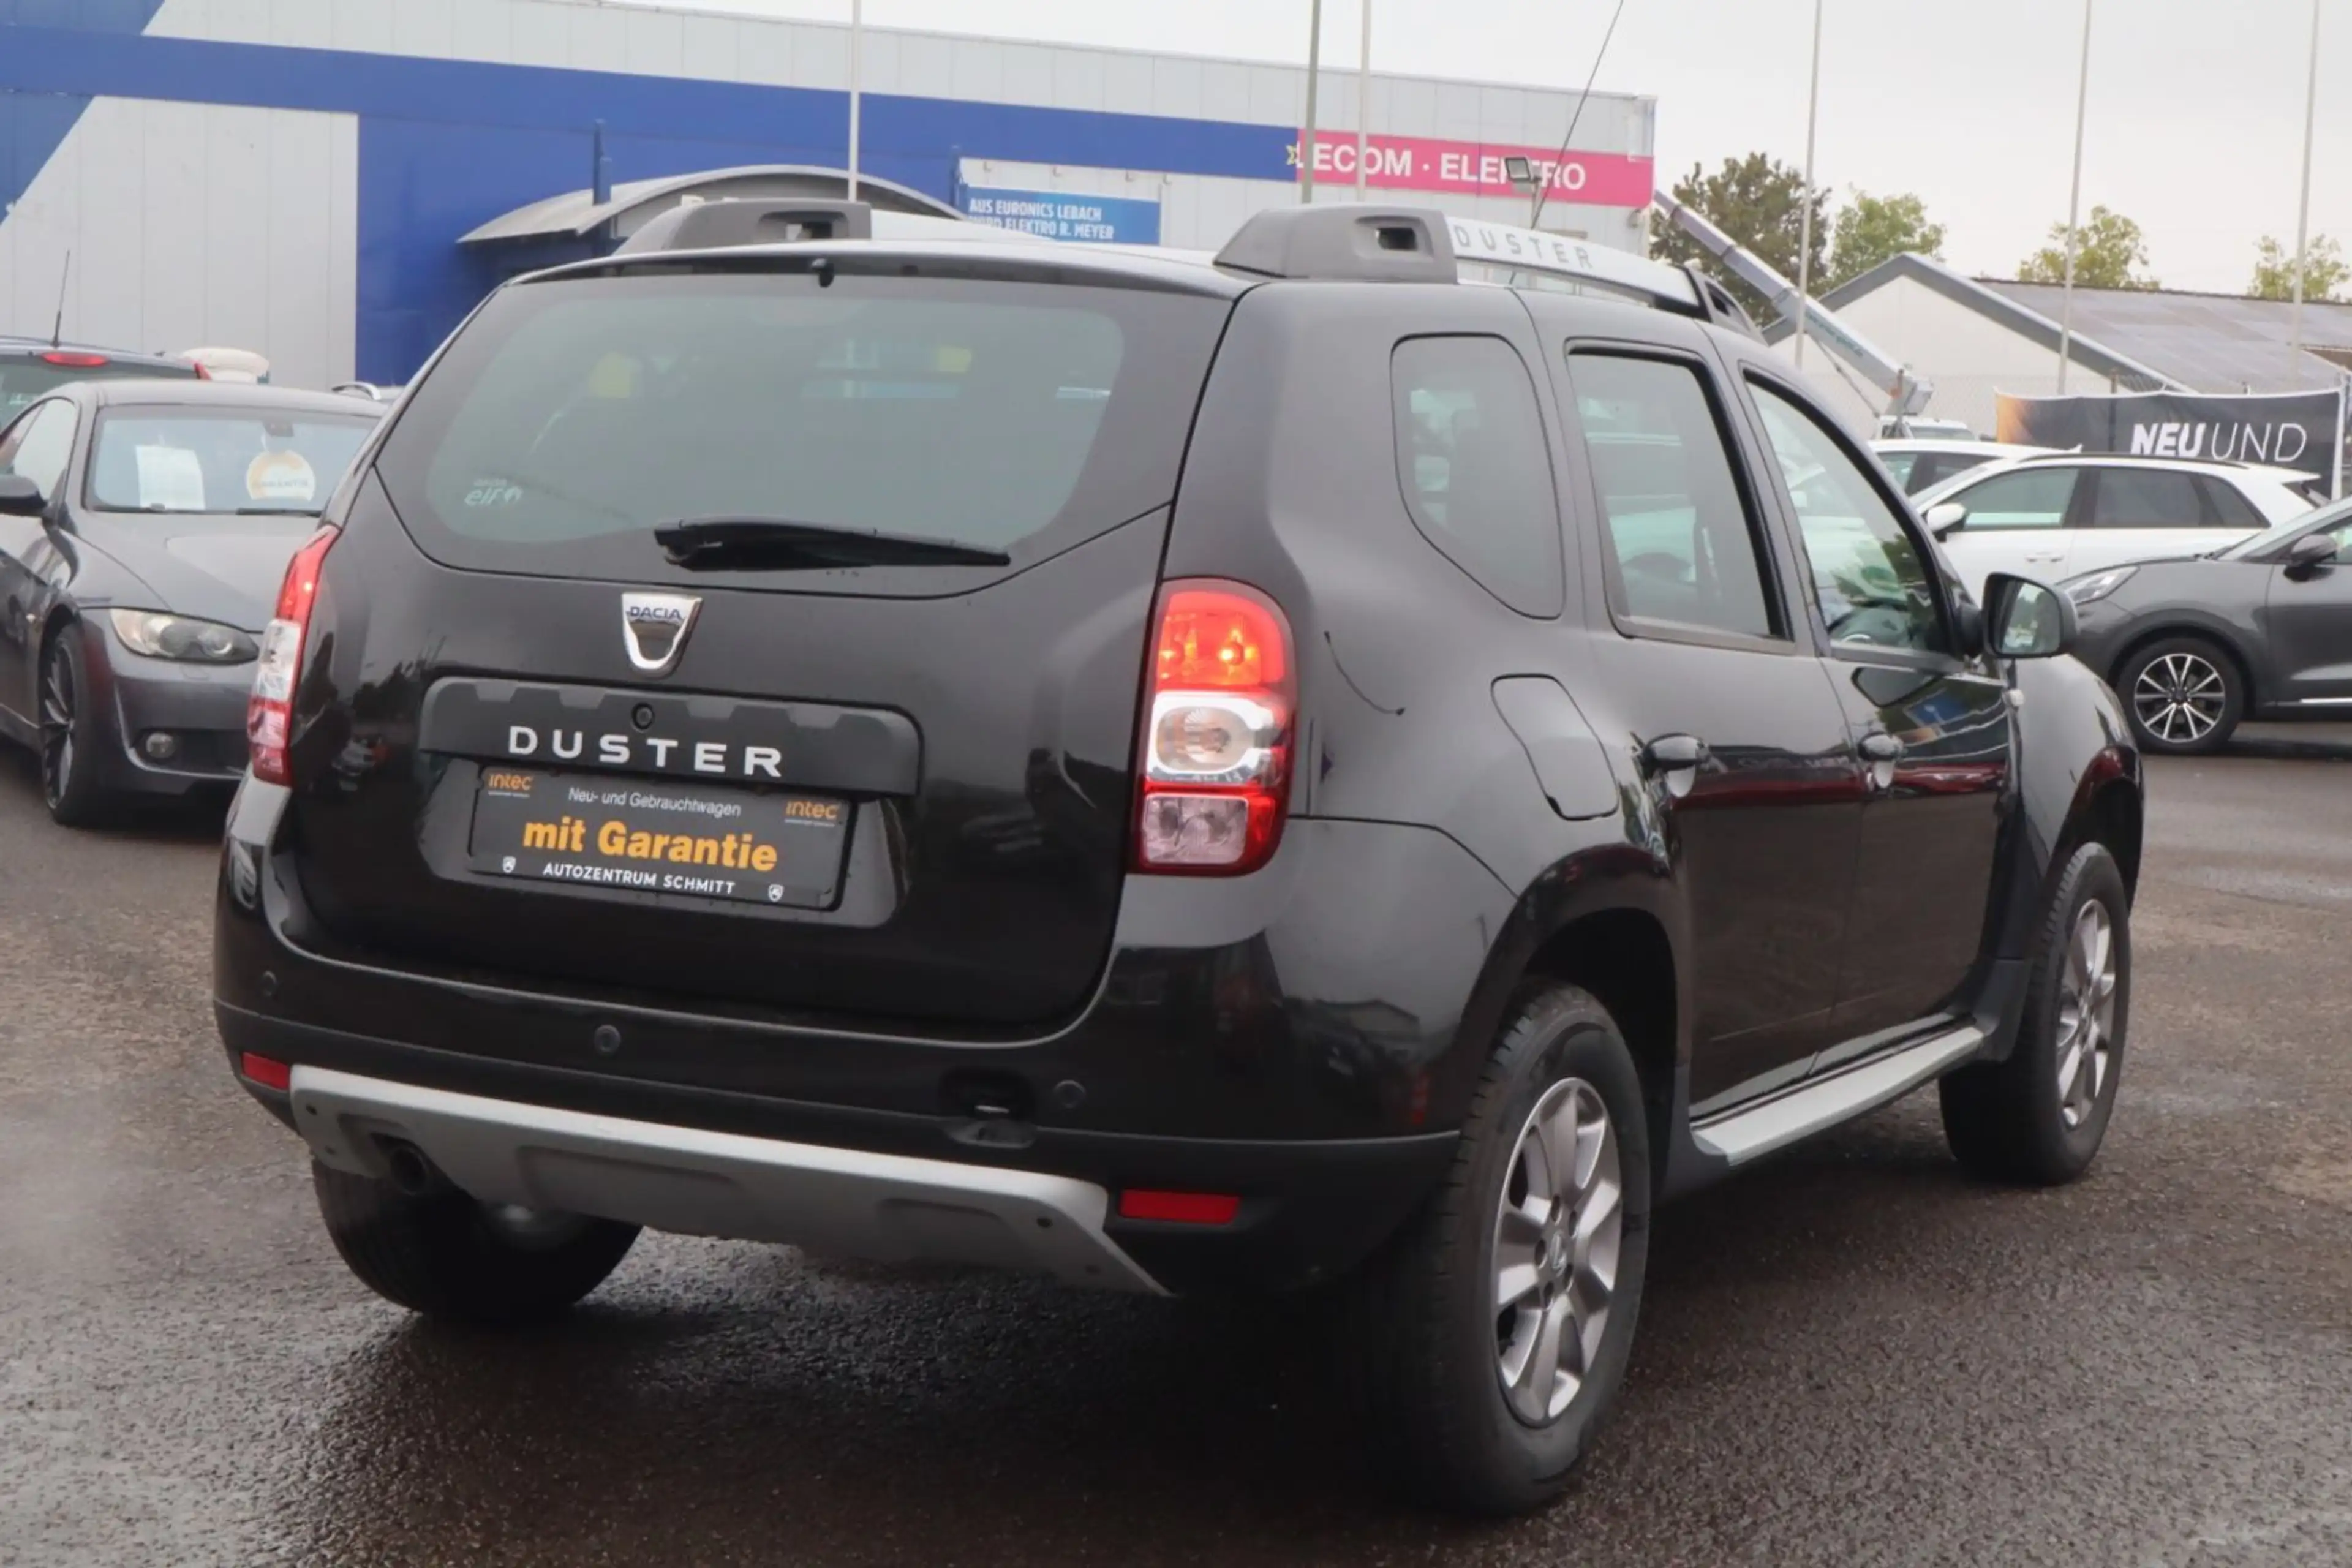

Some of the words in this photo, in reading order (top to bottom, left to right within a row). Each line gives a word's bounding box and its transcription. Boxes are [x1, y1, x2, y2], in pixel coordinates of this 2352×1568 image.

[969, 198, 992, 213] AUS
[995, 199, 1055, 219] EURONICS
[1057, 204, 1103, 221] LEBACH
[1005, 217, 1056, 236] ELEKTRO
[1074, 223, 1115, 239] MEYER
[1453, 225, 1593, 269] DUSTER
[2130, 423, 2206, 458] NEU
[2211, 423, 2307, 462] UND
[629, 606, 682, 620] DACIA
[507, 725, 782, 778] DUSTER
[488, 772, 534, 790] intec
[568, 787, 599, 803] Neu-
[602, 792, 626, 805] und
[629, 793, 742, 818] Gebrauchtwagen
[785, 799, 839, 820] intec
[522, 816, 586, 853] mit
[597, 821, 778, 873] Garantie
[542, 862, 657, 888] AUTOZENTRUM
[663, 874, 736, 895] SCHMITT
